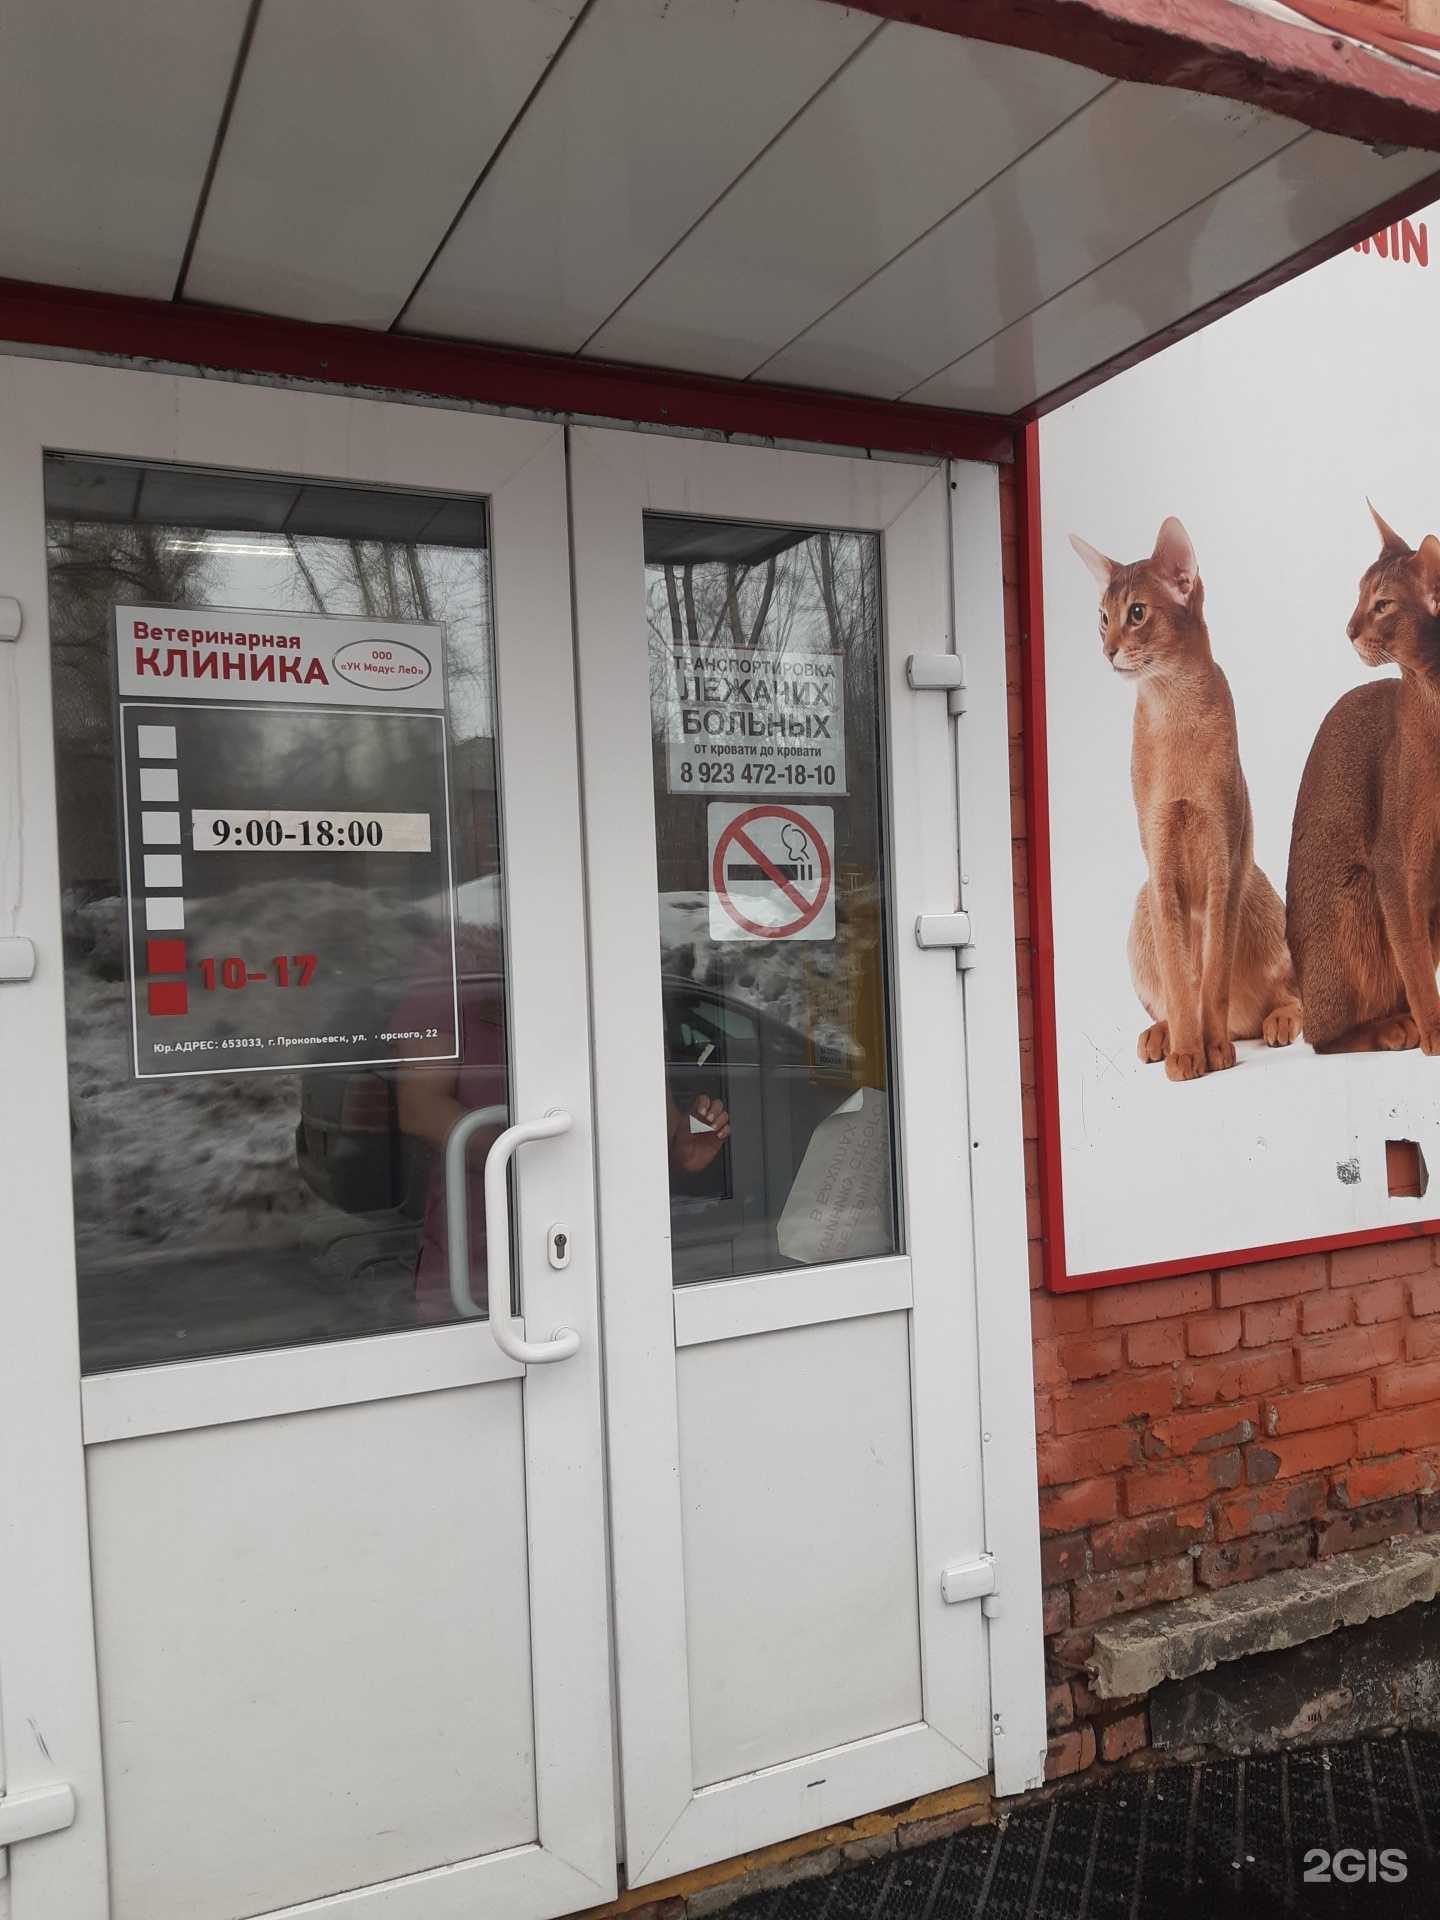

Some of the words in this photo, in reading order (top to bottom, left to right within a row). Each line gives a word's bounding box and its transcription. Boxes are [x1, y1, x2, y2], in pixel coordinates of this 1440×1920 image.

[133, 621, 300, 650] Ветеринарная
[135, 646, 329, 685] КЛИНИКА
[371, 650, 393, 660] ООО
[340, 662, 361, 671] «УК
[363, 663, 395, 674] Модус
[682, 709, 832, 739] БОЛЬНЫХ
[694, 744, 708, 754] от
[710, 744, 757, 757] кровати
[760, 746, 774, 757] до
[777, 747, 822, 759] кровати
[680, 762, 693, 783] 8
[698, 762, 735, 784] 923
[741, 763, 836, 785] 472-18-10
[212, 819, 384, 846] 9:00-18:00
[153, 1040, 219, 1054] Юр.АДРЕС:
[221, 1037, 264, 1049] 653033,
[352, 1034, 367, 1044] ул.
[425, 1029, 438, 1038] 22
